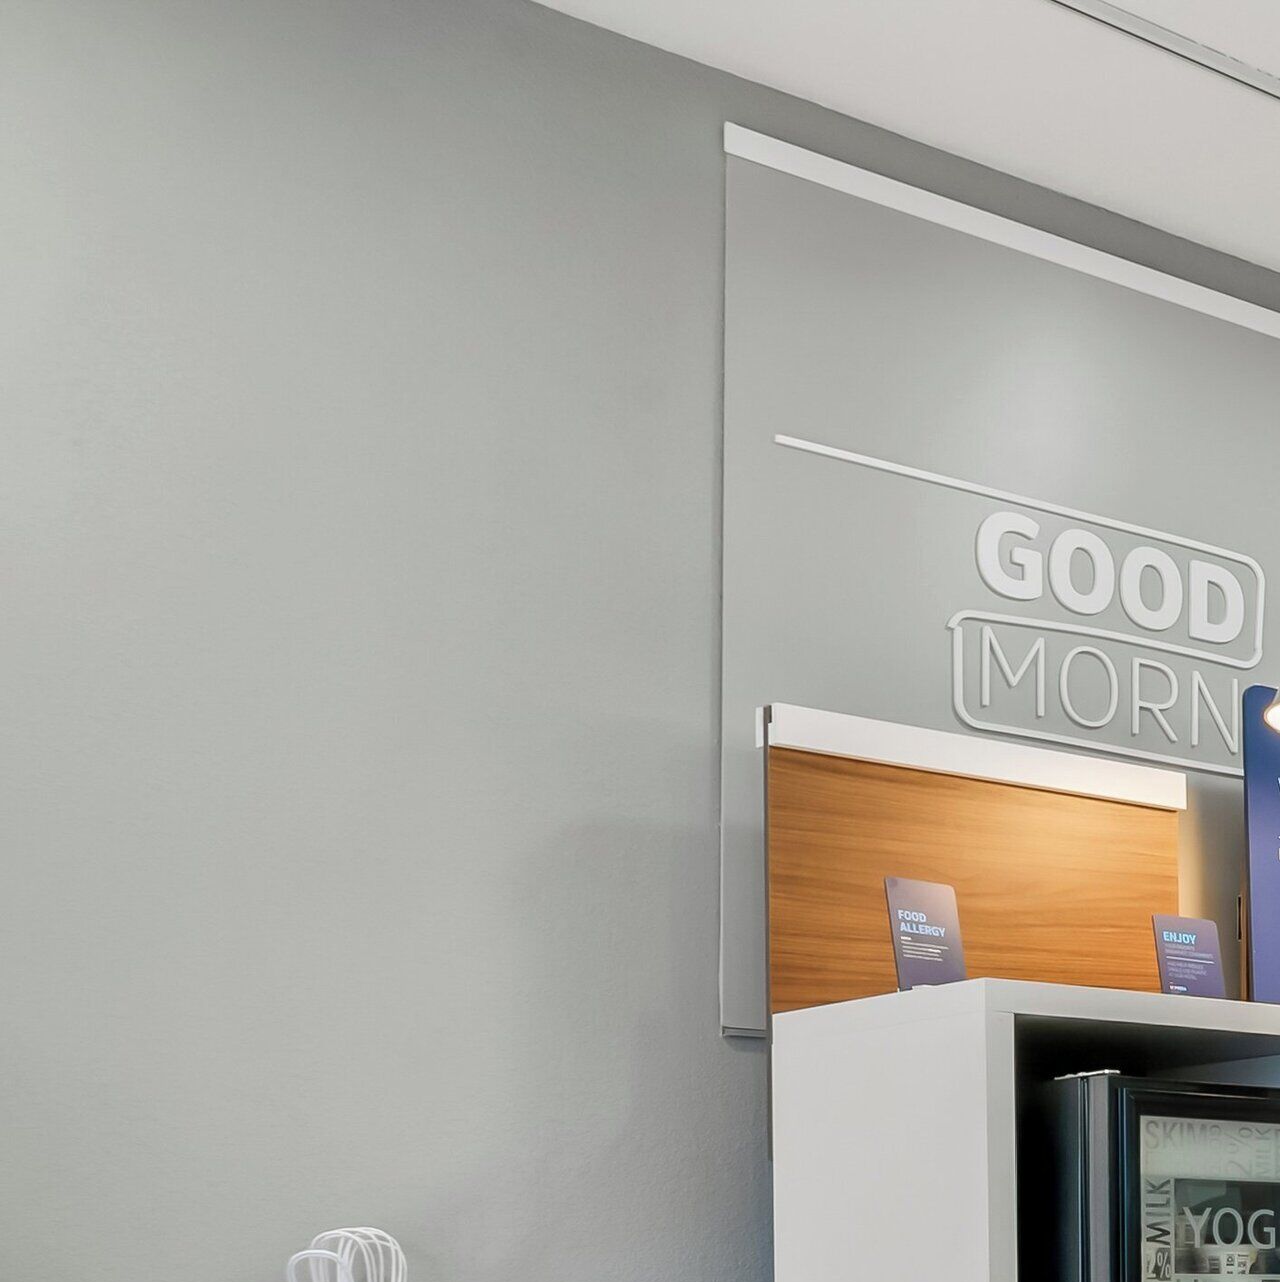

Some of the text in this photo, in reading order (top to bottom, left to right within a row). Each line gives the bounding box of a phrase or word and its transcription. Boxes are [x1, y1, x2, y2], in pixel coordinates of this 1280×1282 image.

[974, 510, 1247, 645] GOOD
[980, 625, 1239, 755] MORN
[897, 909, 927, 922] FOOD
[900, 921, 946, 938] ALLERGY
[1163, 931, 1197, 945] ENJOY
